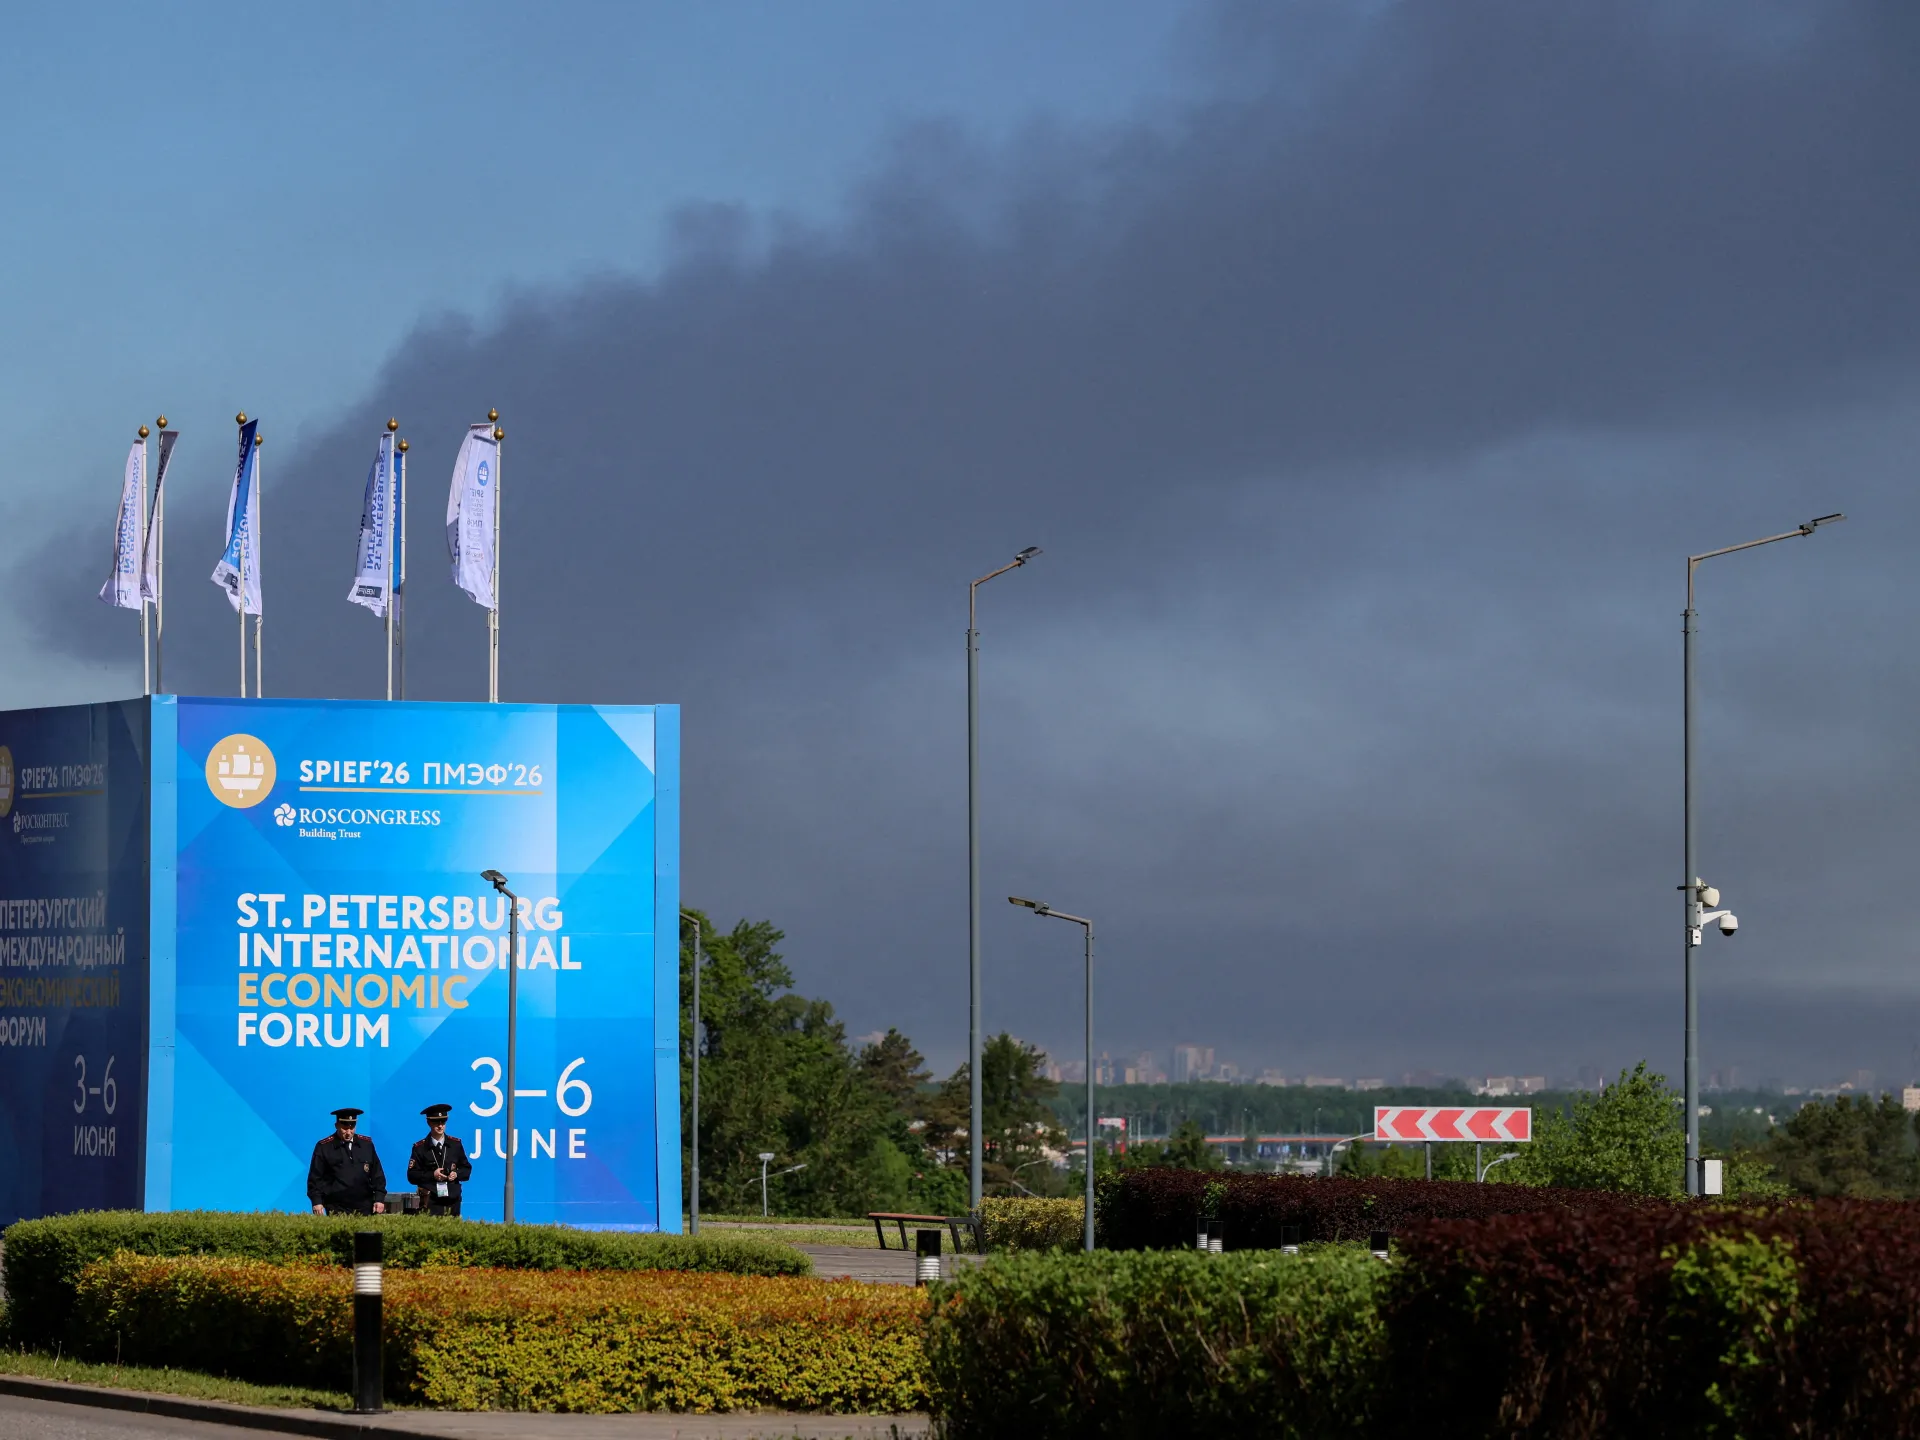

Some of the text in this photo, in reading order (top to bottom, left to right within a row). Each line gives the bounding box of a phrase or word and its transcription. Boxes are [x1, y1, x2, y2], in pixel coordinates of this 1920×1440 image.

[299, 759, 543, 786] SPIEF'26 ПМЭФ'26
[299, 808, 441, 826] ROSCONGRESS
[299, 828, 361, 840] Building Trust
[0, 890, 105, 929] ПЕТЕРБУРГСКИЙ
[237, 892, 563, 931] ST. PETERSBURG
[0, 927, 125, 970] МЕЖДУНАРОДНЫЙ
[238, 934, 582, 970] INTERNATIONAL
[0, 969, 120, 1008] ЭКОНОМИЧЕСКИЙ
[238, 973, 469, 1009] ECONOMIC
[0, 1016, 46, 1046] ФОРУМ
[238, 1013, 390, 1048] FORUM
[74, 1125, 116, 1158] ИЮНЯ
[469, 1128, 586, 1159] JUNE
